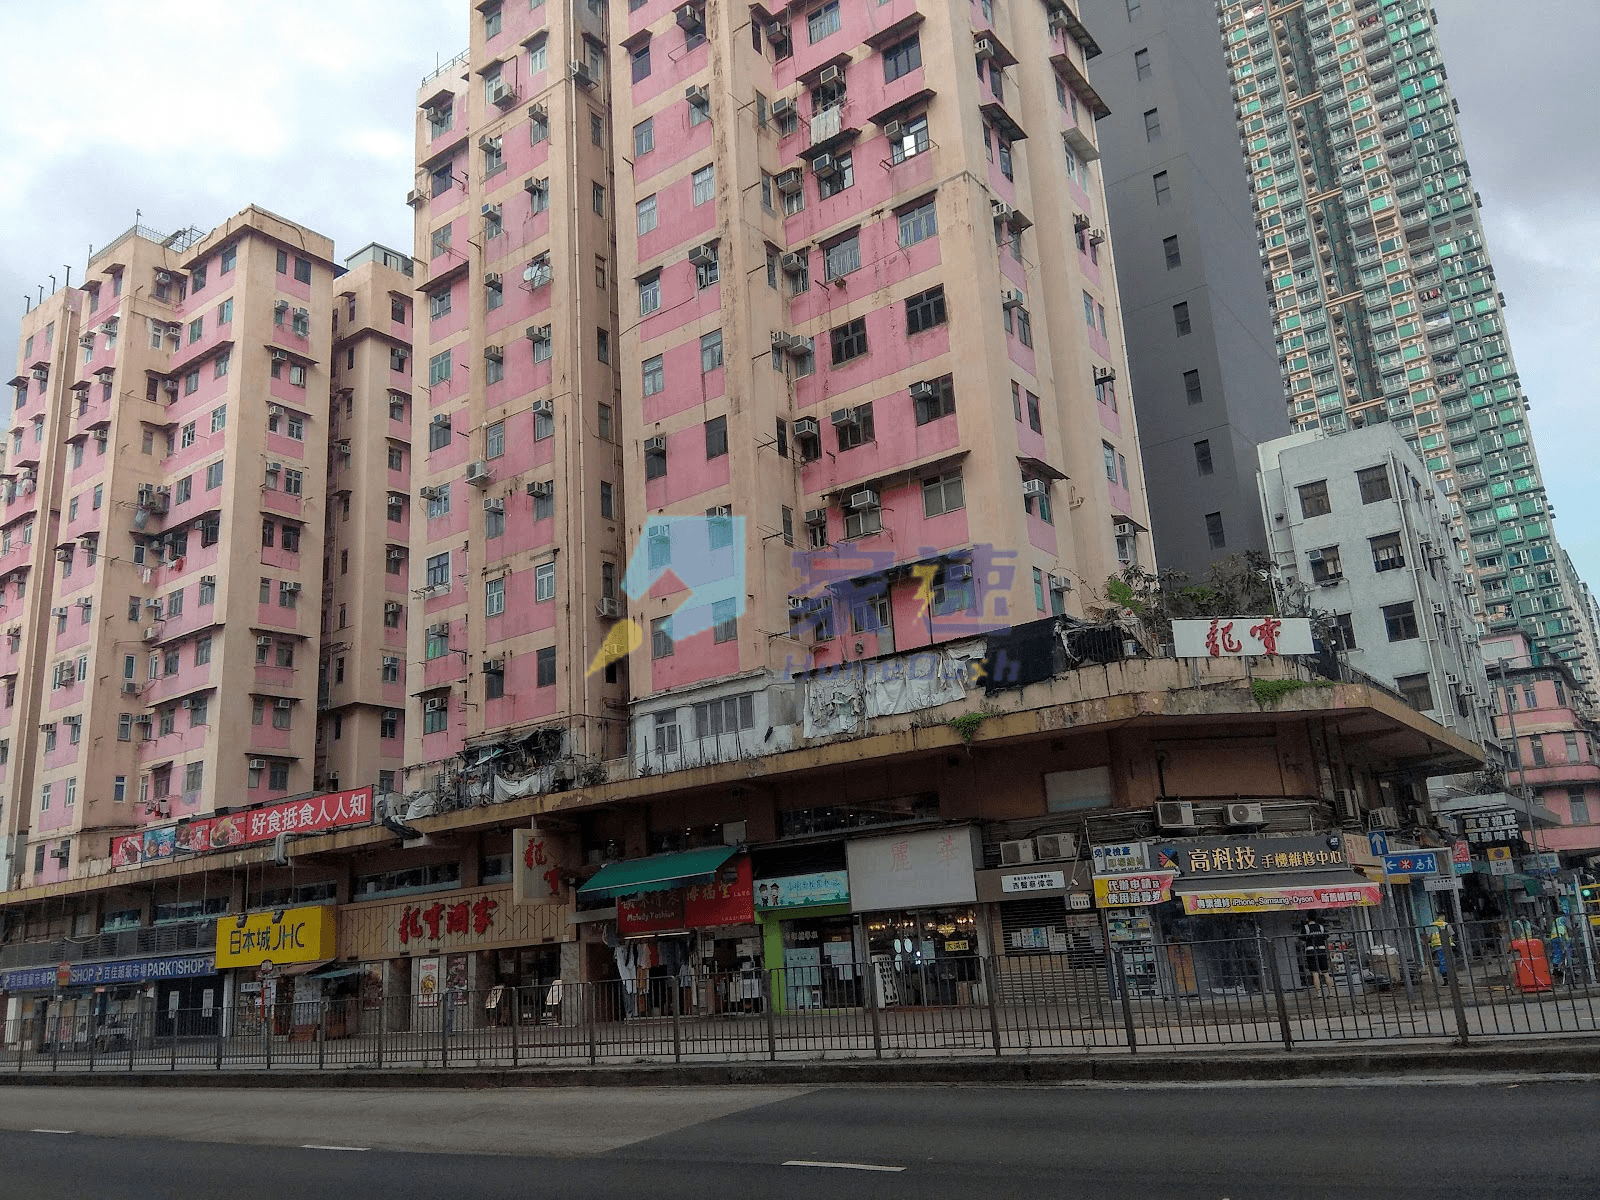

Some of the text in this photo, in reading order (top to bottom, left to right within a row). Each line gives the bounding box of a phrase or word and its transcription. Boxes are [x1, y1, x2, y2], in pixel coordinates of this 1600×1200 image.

[251, 793, 367, 837] 好食抵食人人知
[1187, 846, 1258, 872] 高科技
[1261, 850, 1343, 869] 手機維修中心
[1293, 895, 1314, 904] Dyson
[230, 922, 306, 955] 日本城 JHC
